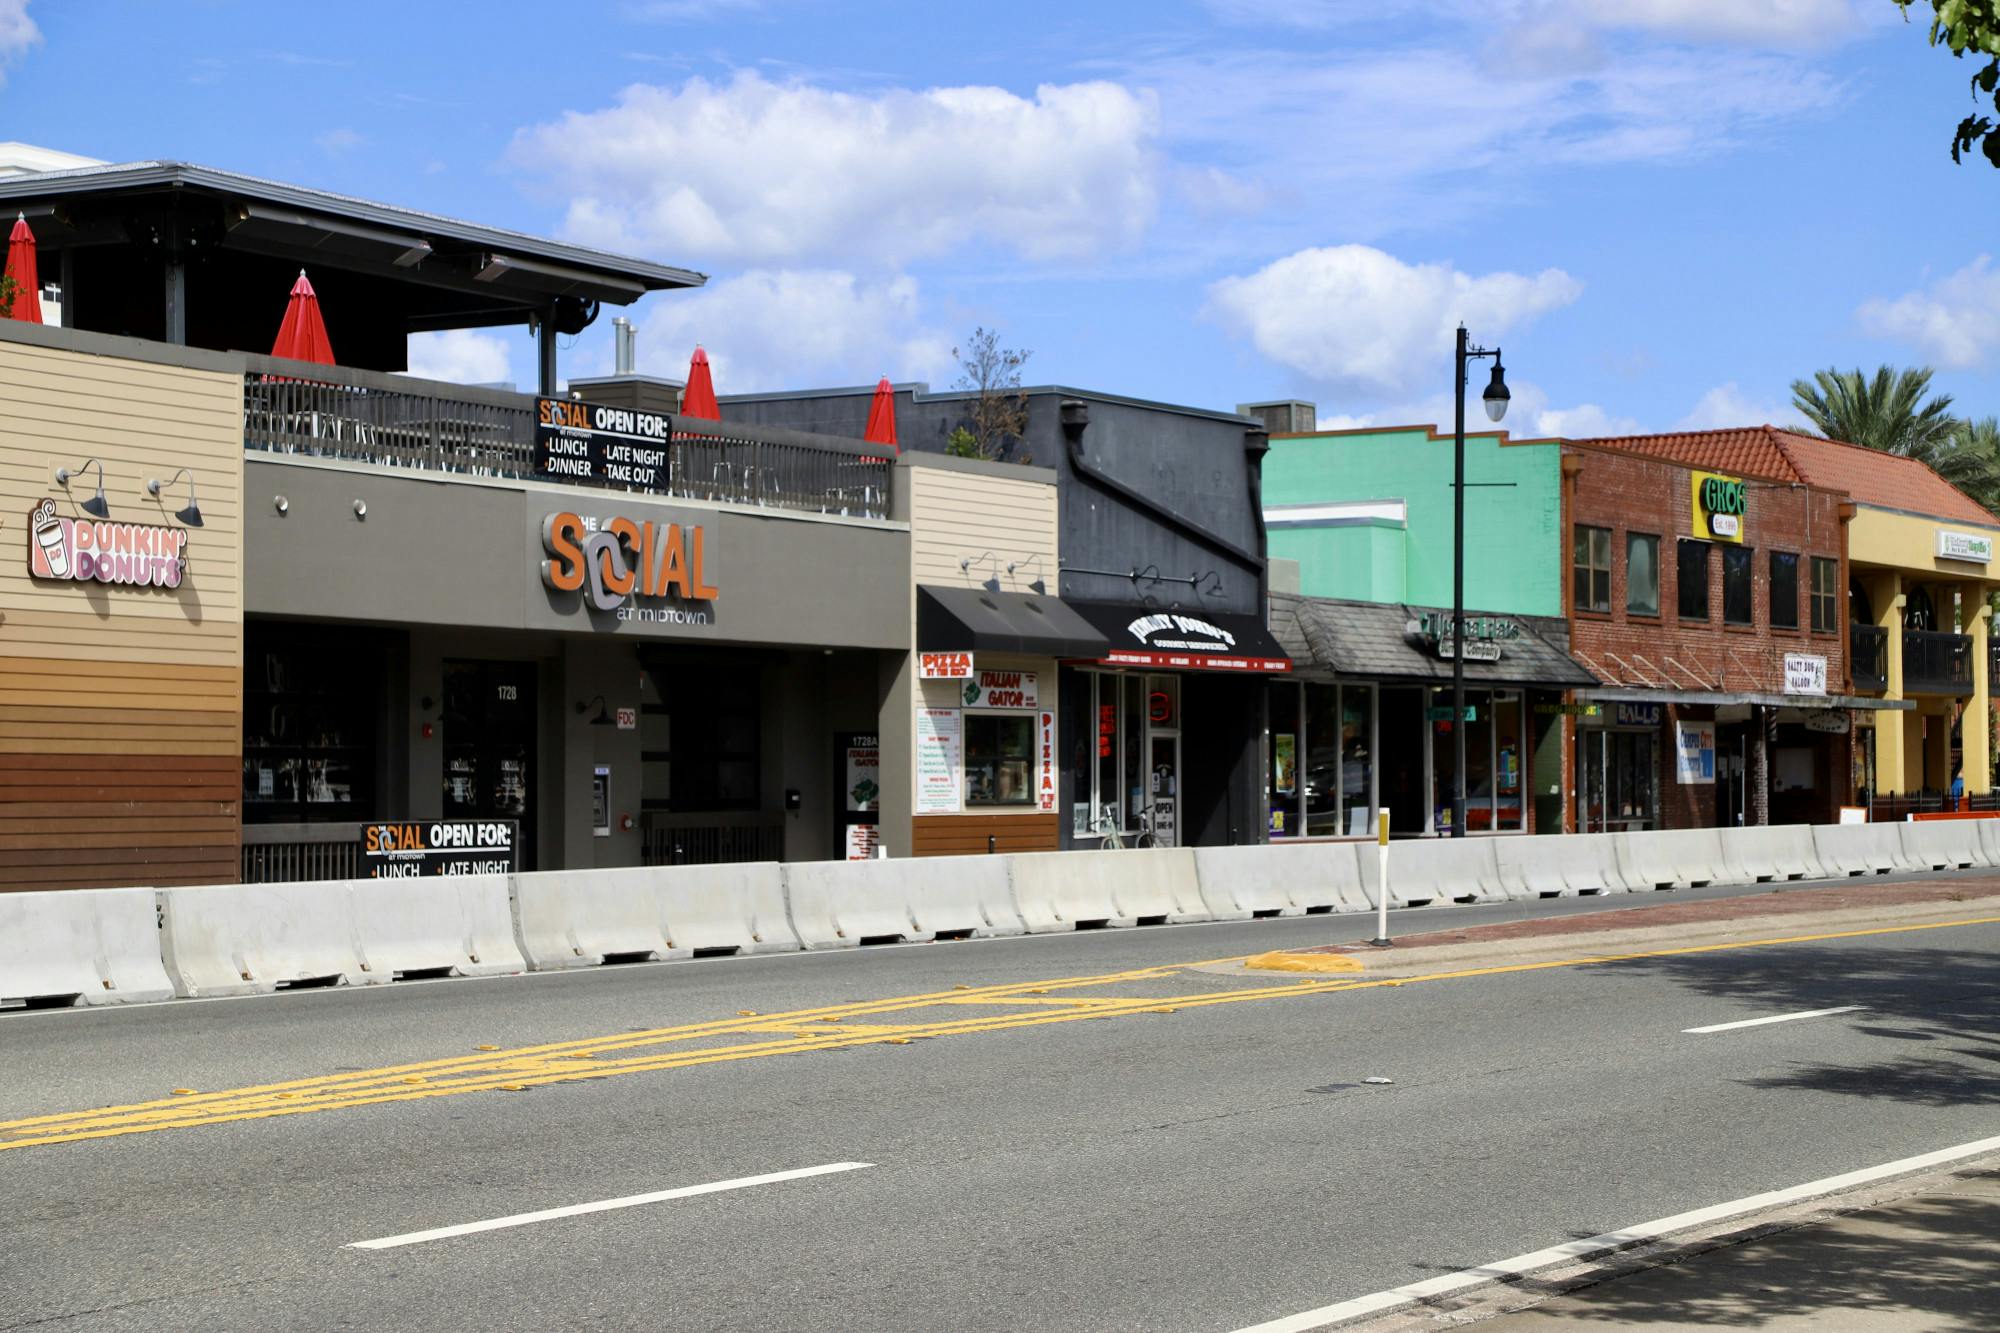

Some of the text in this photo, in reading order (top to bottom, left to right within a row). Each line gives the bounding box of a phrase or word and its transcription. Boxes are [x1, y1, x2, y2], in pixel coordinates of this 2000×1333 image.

[595, 407, 634, 433] OPEN
[637, 413, 668, 437] FOR:
[549, 437, 665, 467] LUNCH LATE NIGHT
[547, 457, 655, 484] DINNER TAKE OUT
[1705, 478, 1746, 515] GROG
[75, 519, 188, 559] DUNKIN'
[50, 548, 62, 560] DD
[542, 512, 719, 610] SOCIAL
[75, 550, 182, 588] DONUTS
[922, 653, 970, 668] PIZZA
[1787, 661, 1815, 673] SALTY DOG
[980, 671, 1021, 688] ITALIAN
[498, 686, 517, 700] 1728
[988, 691, 1024, 707] GATOR
[618, 711, 635, 725] FDC
[1618, 703, 1660, 724] BALLS
[852, 736, 878, 747] 1728A
[1042, 713, 1052, 790] PIZZA
[430, 824, 474, 847] OPEN
[477, 823, 511, 847] FOR:
[376, 860, 510, 879] LUNCH LATE NIGHT
